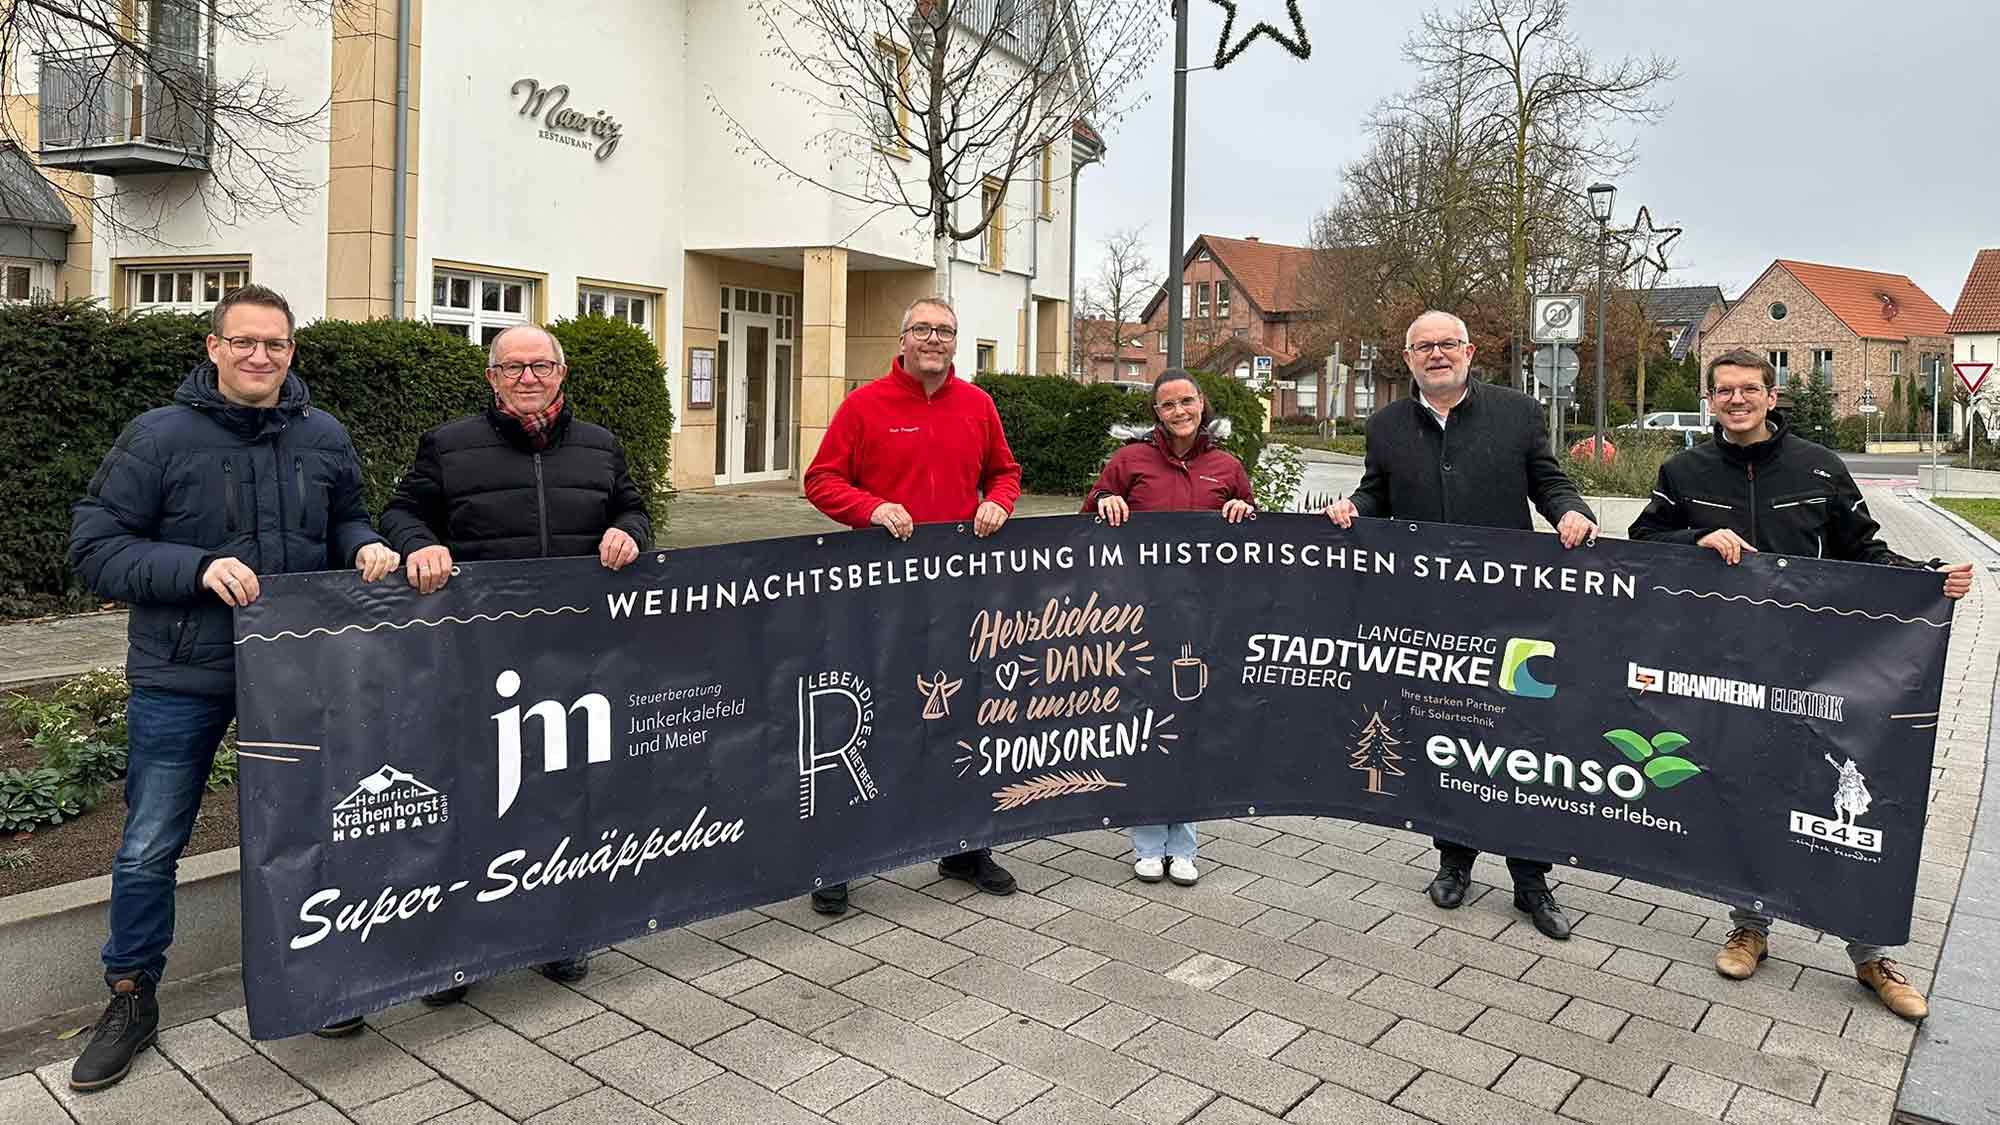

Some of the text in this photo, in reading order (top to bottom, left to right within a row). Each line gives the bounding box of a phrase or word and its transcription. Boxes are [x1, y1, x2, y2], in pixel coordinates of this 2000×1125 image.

[511, 78, 622, 161] Mauritz
[538, 130, 593, 151] RESTAURANT
[1549, 308, 1567, 323] 20
[606, 541, 1637, 620] WEIHNACHTSBELEUCHTUNG IM HISTORISCHEN STADTKERN
[970, 591, 1144, 663] Herzlichen
[1357, 623, 1497, 655] LANGENBERG
[1046, 640, 1127, 684] DANK
[1241, 665, 1353, 691] RIETBERG
[1245, 633, 1495, 688] STADTWERKE
[628, 683, 723, 708] Steuerberatung
[808, 670, 874, 750] LEBENDIGES
[976, 686, 1121, 726] an unsere
[1400, 687, 1507, 714] Ihre starken Partner
[1668, 671, 1845, 722] BRANDHERM ELEKTRIK
[627, 699, 746, 735] Junkerkalefeld
[1409, 704, 1495, 729] für Solartechnik
[490, 669, 612, 819] jm
[629, 727, 709, 758] und Meier
[978, 708, 1154, 776] SPONSOREN!
[847, 745, 879, 800] RIETBERG
[1425, 735, 1647, 801] ewenso
[332, 796, 440, 828] Krähenhorst
[355, 785, 419, 807] Heinrich
[440, 793, 449, 823] GmbH
[1439, 772, 1690, 836] Energie bewusst erleben.
[332, 813, 438, 842] HOCHBAU
[1796, 815, 1875, 848] 1643
